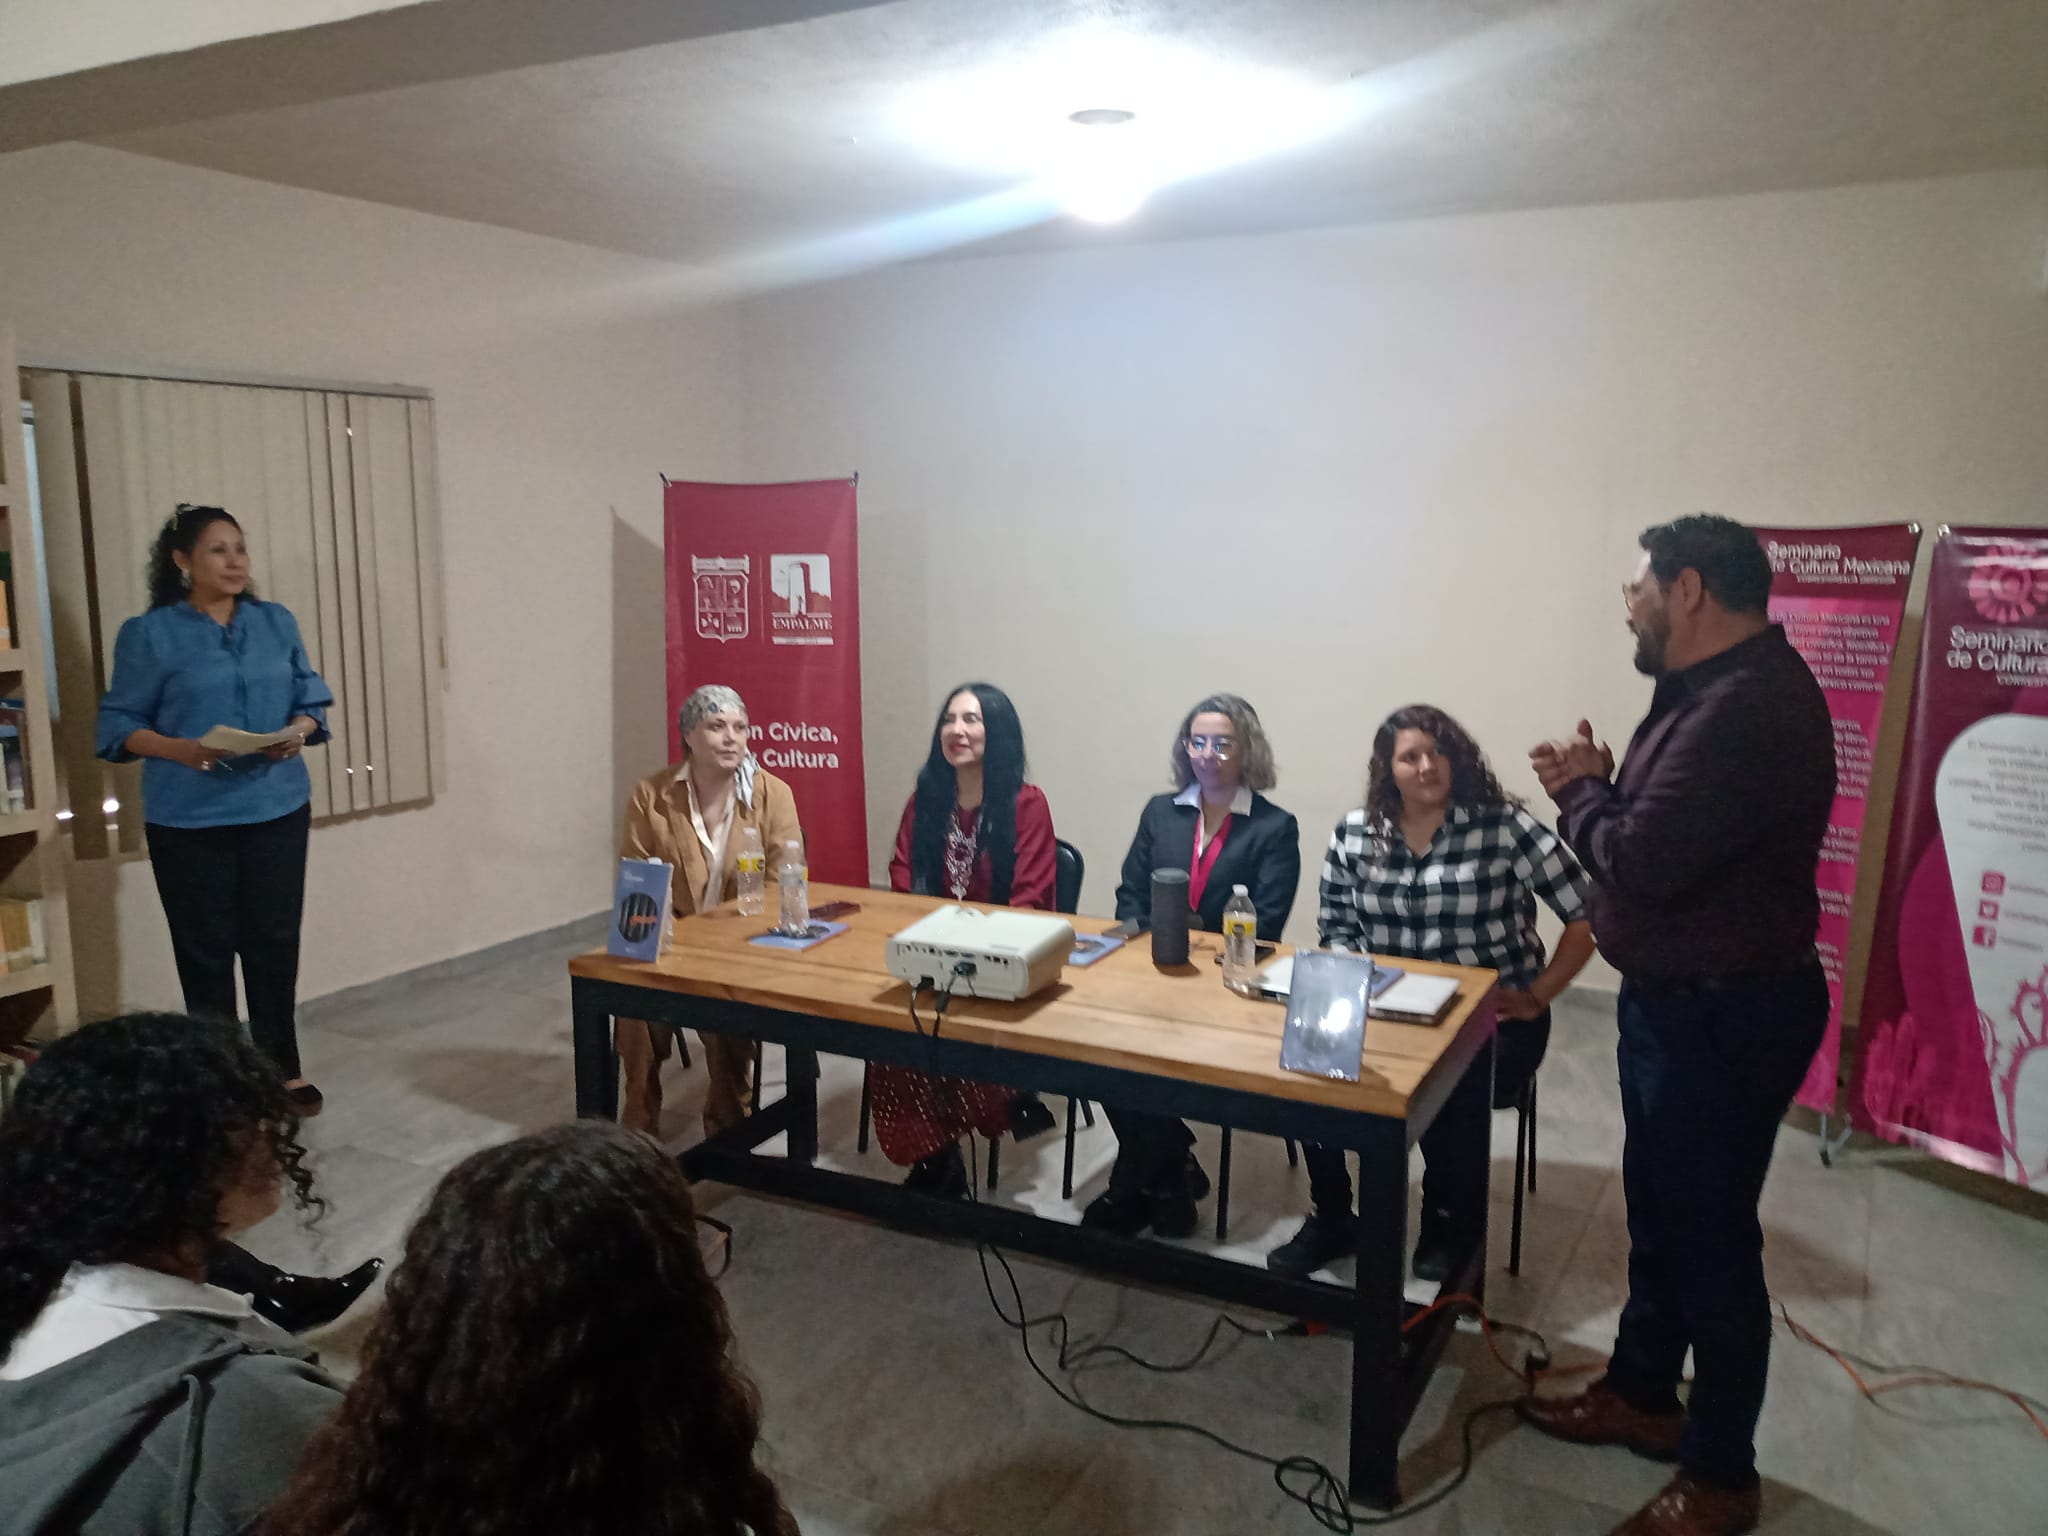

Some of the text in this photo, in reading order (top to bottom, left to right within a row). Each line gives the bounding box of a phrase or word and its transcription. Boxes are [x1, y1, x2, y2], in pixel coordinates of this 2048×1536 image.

[1768, 540, 1841, 560] Seminario
[1790, 558, 1839, 574] Cultura
[1844, 556, 1911, 576] Mexicana
[772, 617, 832, 630] EMPALME
[1947, 648, 1972, 669] de
[762, 748, 839, 769] Cultura
